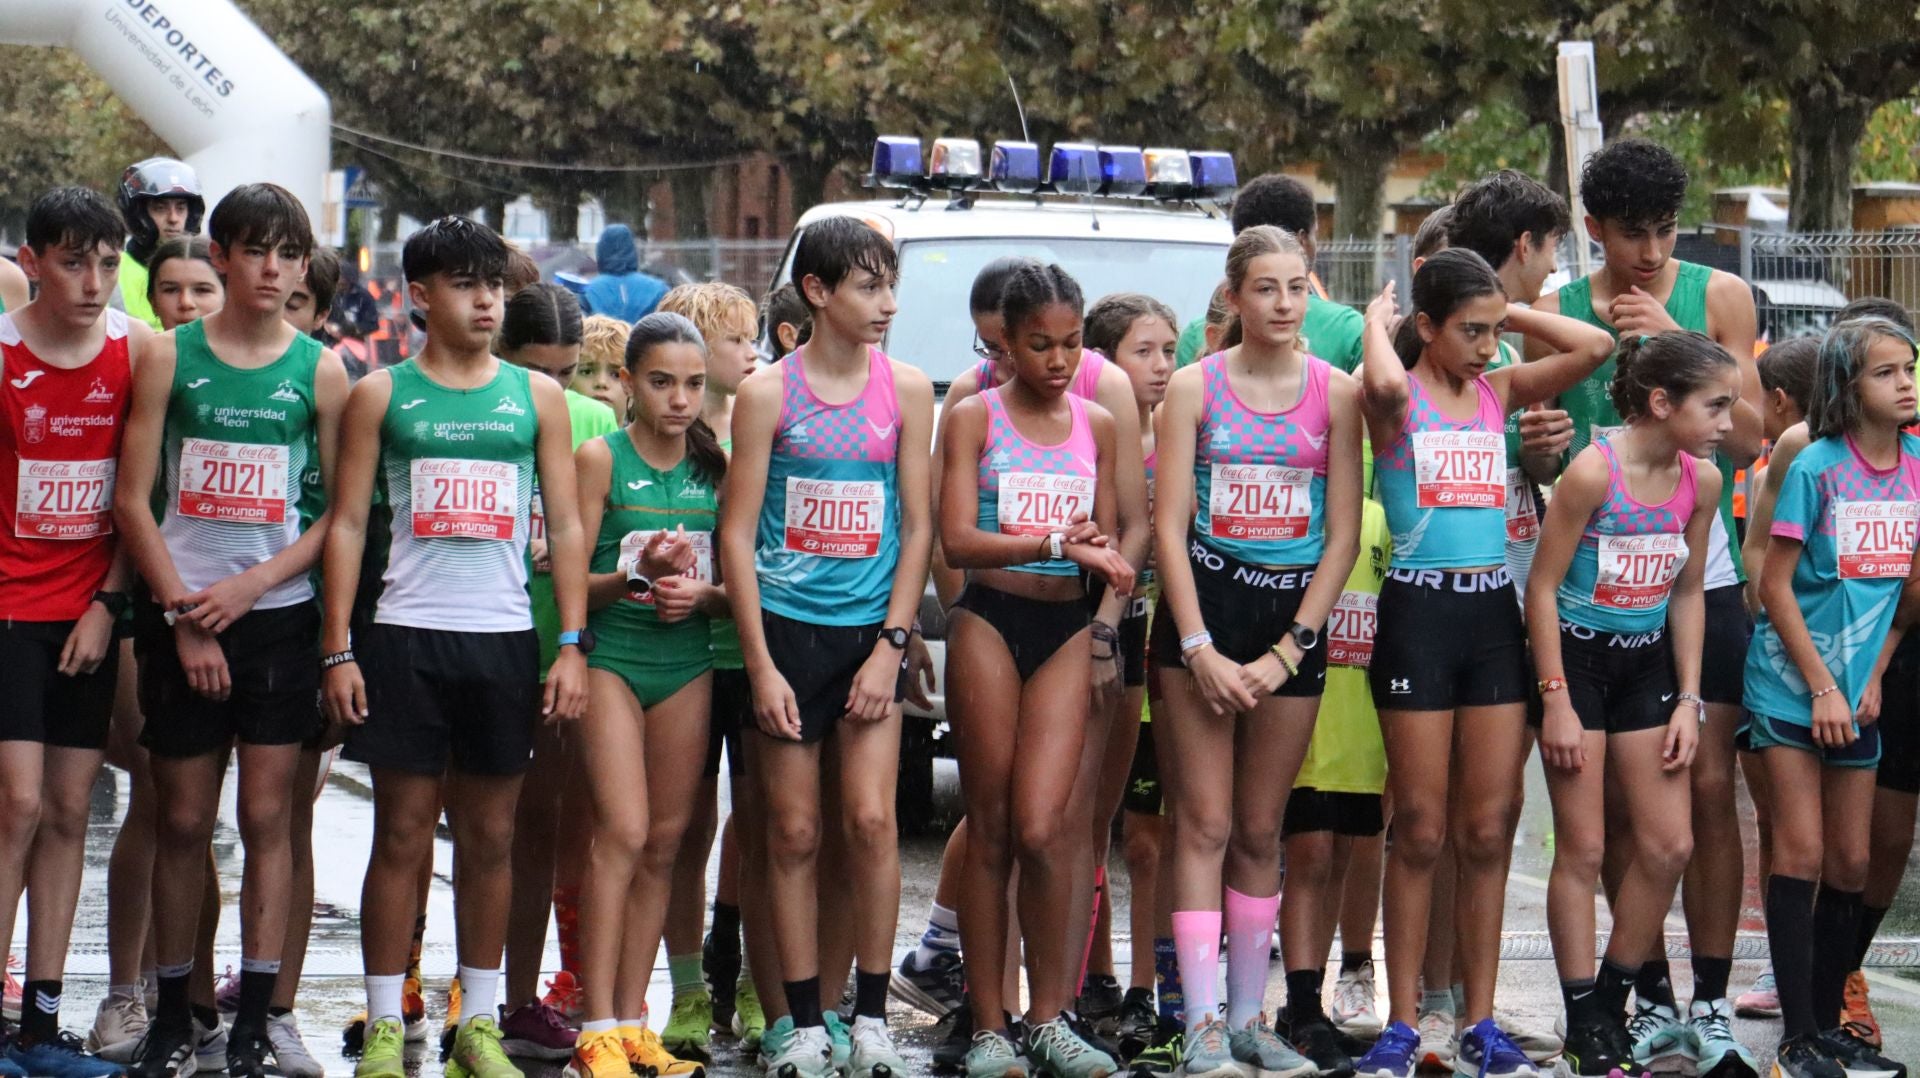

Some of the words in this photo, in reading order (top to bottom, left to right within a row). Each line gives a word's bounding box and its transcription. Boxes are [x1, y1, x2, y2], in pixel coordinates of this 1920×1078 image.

[126, 0, 234, 97] DEPORTES
[105, 8, 169, 74] Universidad
[169, 74, 184, 90] de
[185, 88, 214, 117] León
[50, 415, 113, 426] universidad
[214, 406, 286, 421] universidad
[433, 421, 515, 432] universidad
[201, 460, 265, 497] 2021
[1435, 450, 1494, 481] 2037
[37, 480, 104, 513] 2022
[433, 478, 497, 512] 2018
[1228, 484, 1293, 515] 2047
[1457, 493, 1496, 503] HYUNDAI
[216, 505, 267, 518] HYUNDAI
[803, 497, 869, 531] 2005
[1017, 492, 1079, 527] 2042
[451, 523, 498, 534] HYUNDAI
[1248, 526, 1294, 536] HYUNDAI
[1856, 521, 1914, 552] 2045
[822, 542, 867, 552] HYUNDAI
[1233, 566, 1296, 589] NIKE
[1608, 630, 1662, 649] NIKE
